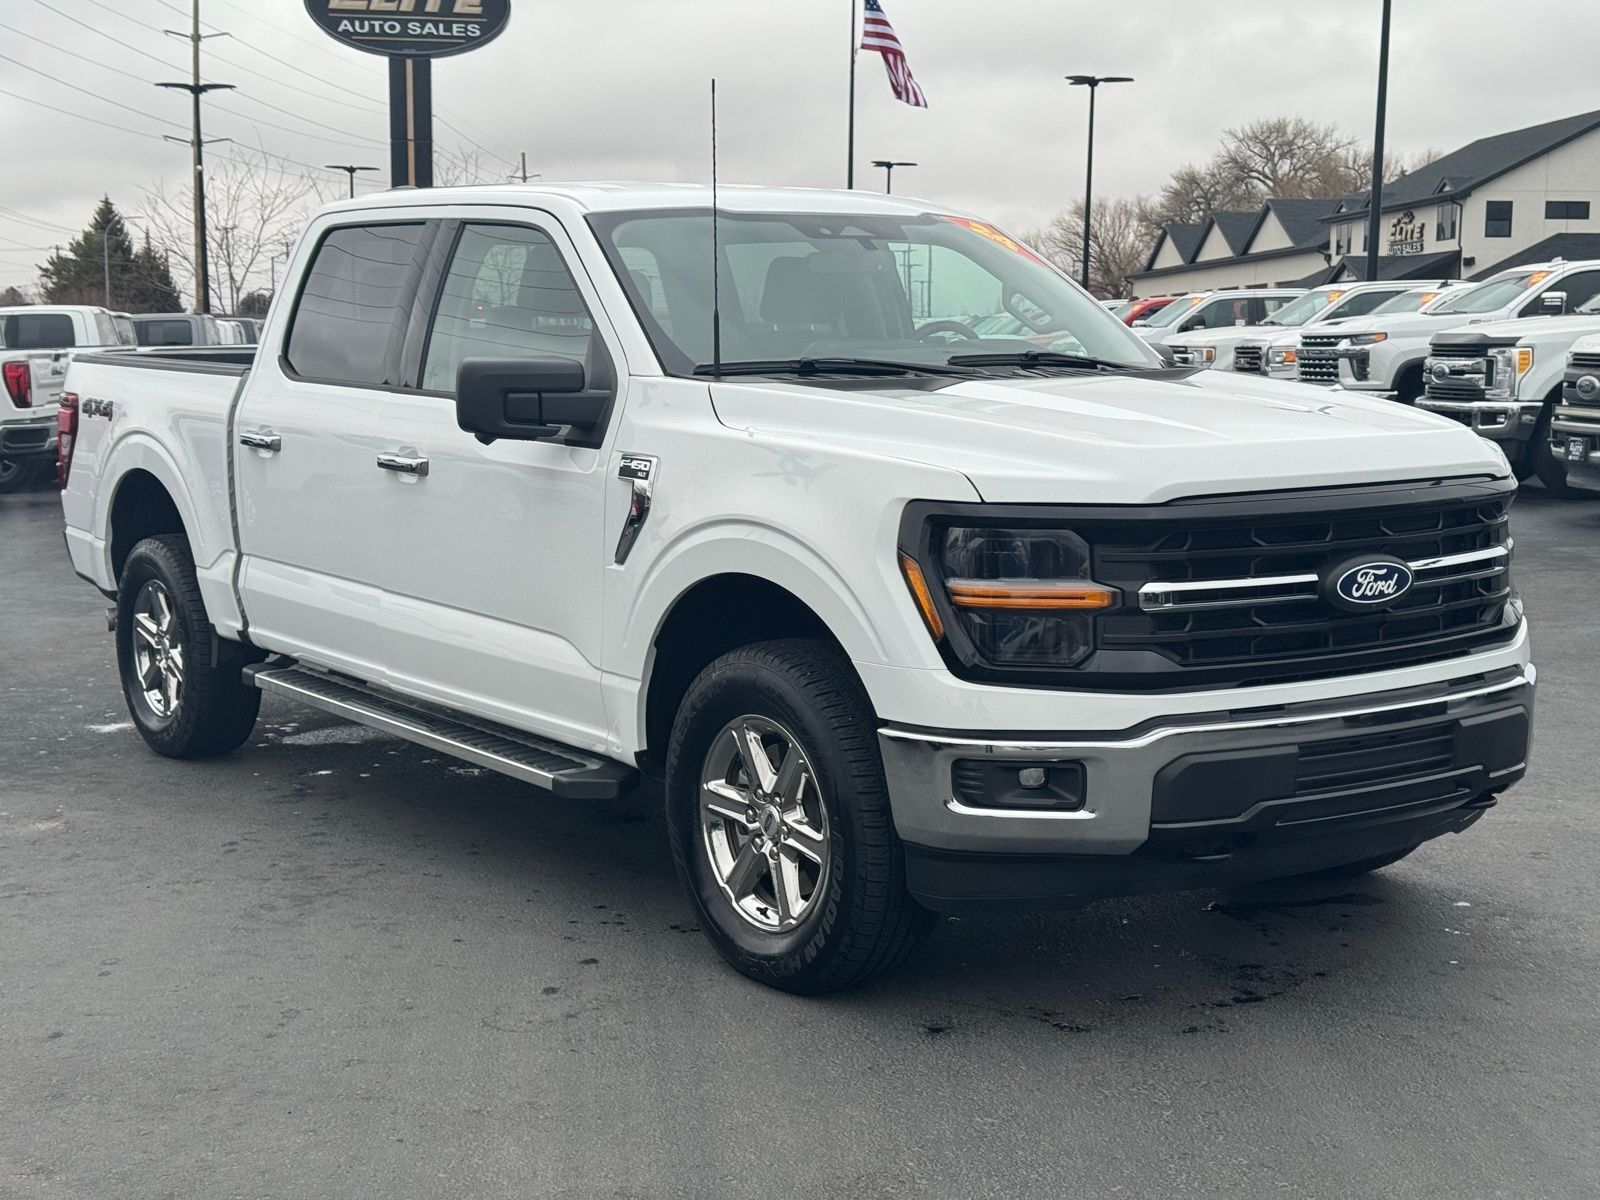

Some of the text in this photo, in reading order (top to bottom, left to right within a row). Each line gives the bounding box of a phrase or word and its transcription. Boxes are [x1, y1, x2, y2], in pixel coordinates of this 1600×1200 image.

[337, 19, 481, 37] AUTO SALES
[1352, 568, 1399, 598] Ford
